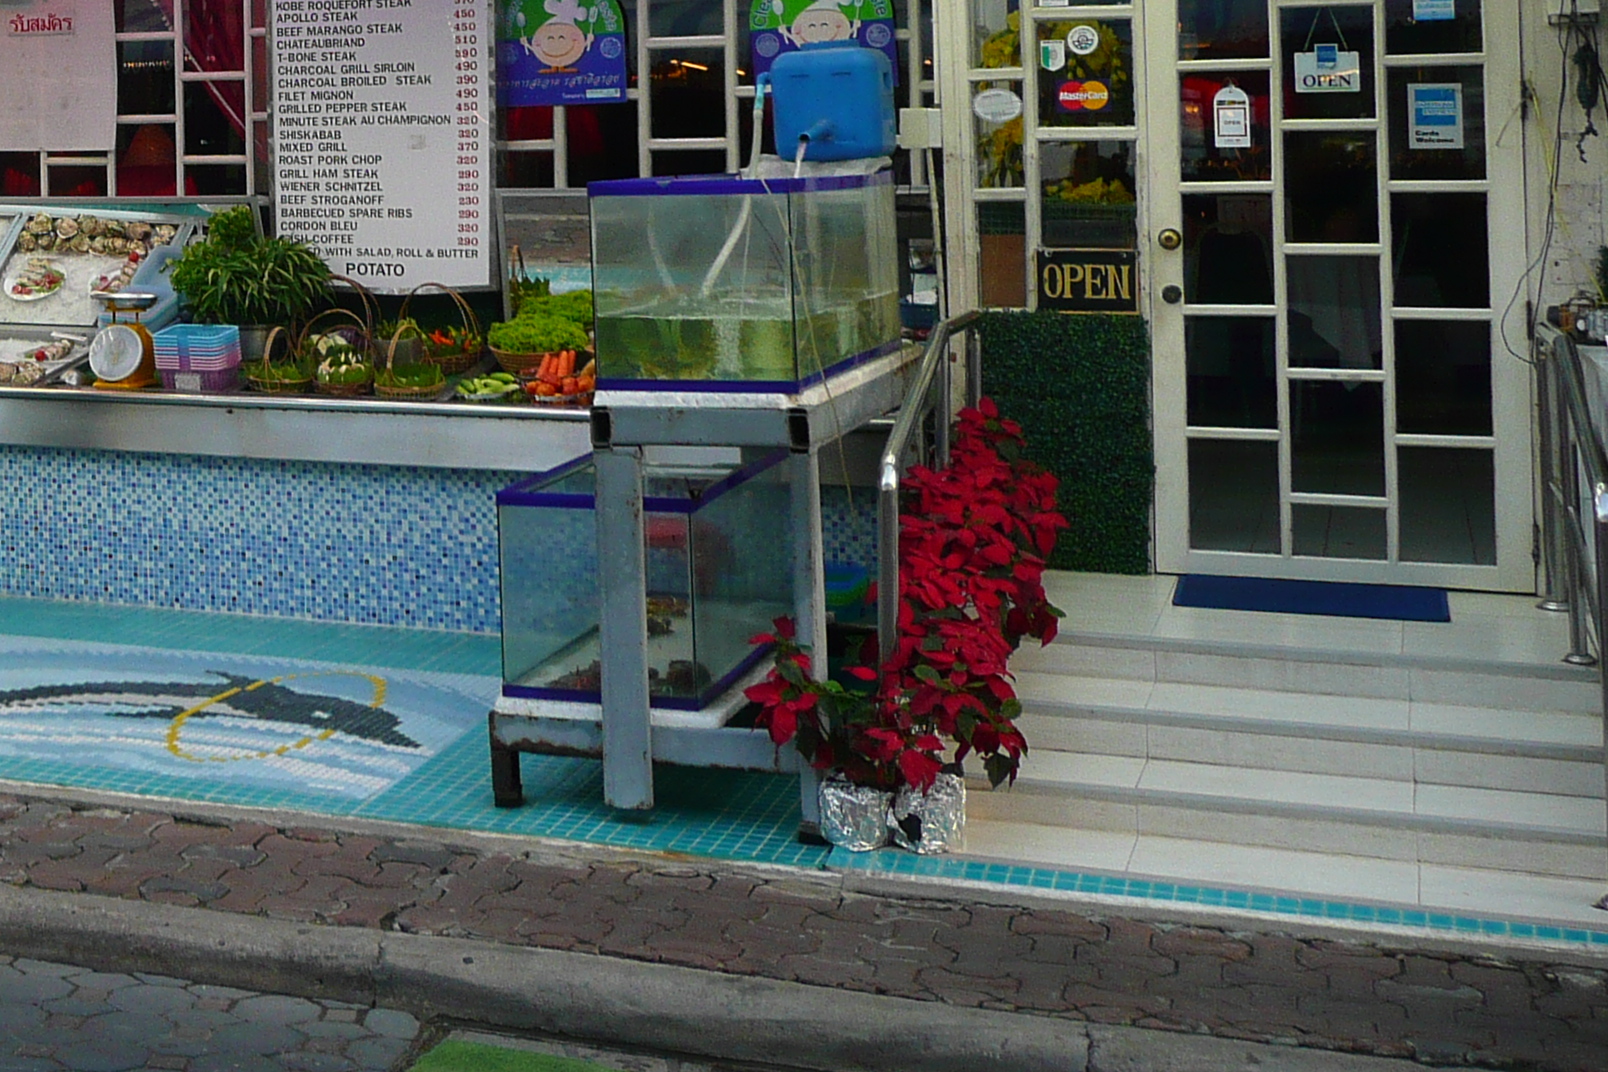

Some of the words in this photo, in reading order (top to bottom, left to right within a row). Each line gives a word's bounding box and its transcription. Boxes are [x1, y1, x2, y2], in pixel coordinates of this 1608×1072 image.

[276, 1, 304, 11] KOBE
[308, 0, 372, 11] ROQUEFORT
[276, 13, 318, 23] APOLLO
[322, 11, 357, 22] STEAK
[454, 9, 475, 18] 450
[10, 12, 72, 32] รับสมัคร
[454, 22, 476, 31] 450
[277, 27, 303, 37] BEEF
[307, 25, 362, 36] MARANGO
[367, 23, 402, 34] STEAK
[277, 37, 365, 50] CHATEAUBRIAND
[455, 35, 476, 45] 510
[277, 52, 316, 63] T-BONE
[321, 51, 356, 62] STEAK
[278, 65, 336, 76] CHARCOAL
[341, 63, 370, 74] GRILL
[374, 62, 414, 73] SIRLOIN
[455, 61, 477, 71] 490
[278, 77, 336, 88] CHARCOAL
[341, 75, 387, 87] BROILED
[396, 74, 431, 85] STEAK
[1303, 74, 1351, 87] OPEN
[278, 91, 305, 101] FILET
[311, 90, 354, 101] MIGNON
[456, 88, 478, 98] 490
[1059, 91, 1108, 100] MasterCard
[279, 103, 322, 114] GRILLED
[326, 102, 367, 113] PEPPER
[371, 101, 407, 112] STEAK
[279, 117, 318, 127] MINUTE
[322, 116, 356, 126] STEAK
[361, 115, 374, 125] AU
[377, 113, 451, 125] CHAMPIGNON
[279, 130, 341, 140] SHISKABAB
[280, 142, 313, 152] MIXED
[318, 142, 347, 152] GRILL
[279, 155, 313, 165] ROAST
[318, 155, 347, 165] PORK
[352, 154, 382, 165] CHOP
[280, 169, 308, 179] GRILL
[313, 168, 337, 178] HAM
[343, 168, 378, 179] STEAK
[280, 181, 320, 192] WIENER
[325, 181, 382, 192] SCHNITZEL
[281, 195, 306, 204] BEEF
[311, 195, 384, 205] STROGANOFF
[281, 208, 344, 218] BARBECUED
[349, 208, 383, 218] SPARE
[388, 208, 412, 218] RIBS
[281, 222, 326, 231] CORDON
[331, 221, 357, 231] BLEU
[315, 234, 354, 244] COFFEE
[325, 247, 352, 257] WITH
[356, 247, 393, 258] SALAD,
[397, 248, 422, 258] ROLL
[426, 249, 434, 258] &
[438, 249, 478, 259] BUTTER
[346, 262, 404, 276] POTATO
[1043, 264, 1130, 299] OPEN
